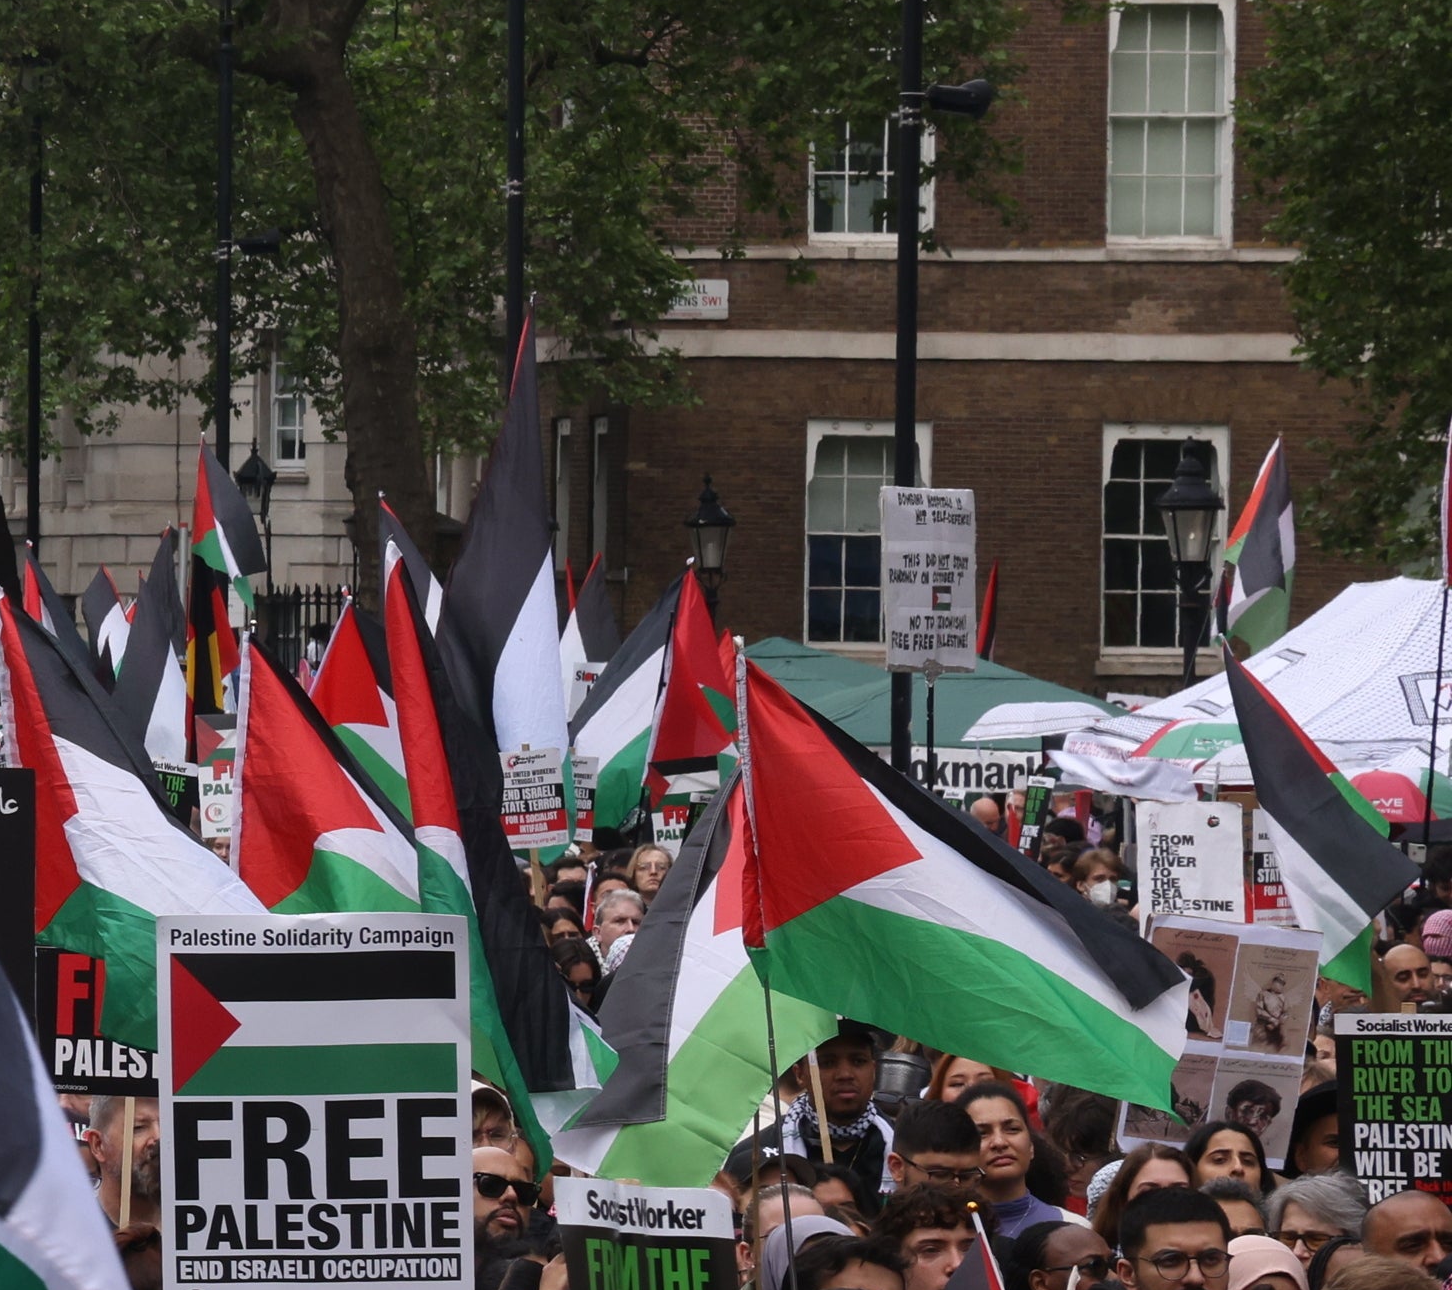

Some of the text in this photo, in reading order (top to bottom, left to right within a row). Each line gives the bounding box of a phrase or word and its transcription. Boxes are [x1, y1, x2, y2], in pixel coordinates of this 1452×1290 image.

[903, 553, 920, 567] THIS
[909, 616, 921, 630] NO
[891, 631, 934, 652] FREE FREE
[522, 785, 555, 799] ISRAELI
[527, 797, 562, 811] TERROR
[526, 811, 557, 822] SOCIALIST
[1150, 835, 1194, 846] FROM
[1150, 846, 1180, 856] THE
[1150, 856, 1196, 867] RIVER
[1150, 868, 1171, 878] TO
[1150, 878, 1180, 889] THE
[1151, 889, 1182, 900] SEA
[1151, 899, 1233, 912] PALESTINE
[170, 926, 455, 949] Palestine Solidarity Campaign
[1356, 1019, 1412, 1033] Socialist
[1352, 1039, 1413, 1065] FROM
[1353, 1067, 1451, 1093] RIVER TO
[1353, 1095, 1443, 1122] THE SEA
[172, 1098, 461, 1201] FREE
[1354, 1151, 1442, 1178] WILL BE
[175, 1203, 461, 1251] PALESTINE
[180, 1256, 458, 1281] END ISRAELI OCCUPATION
